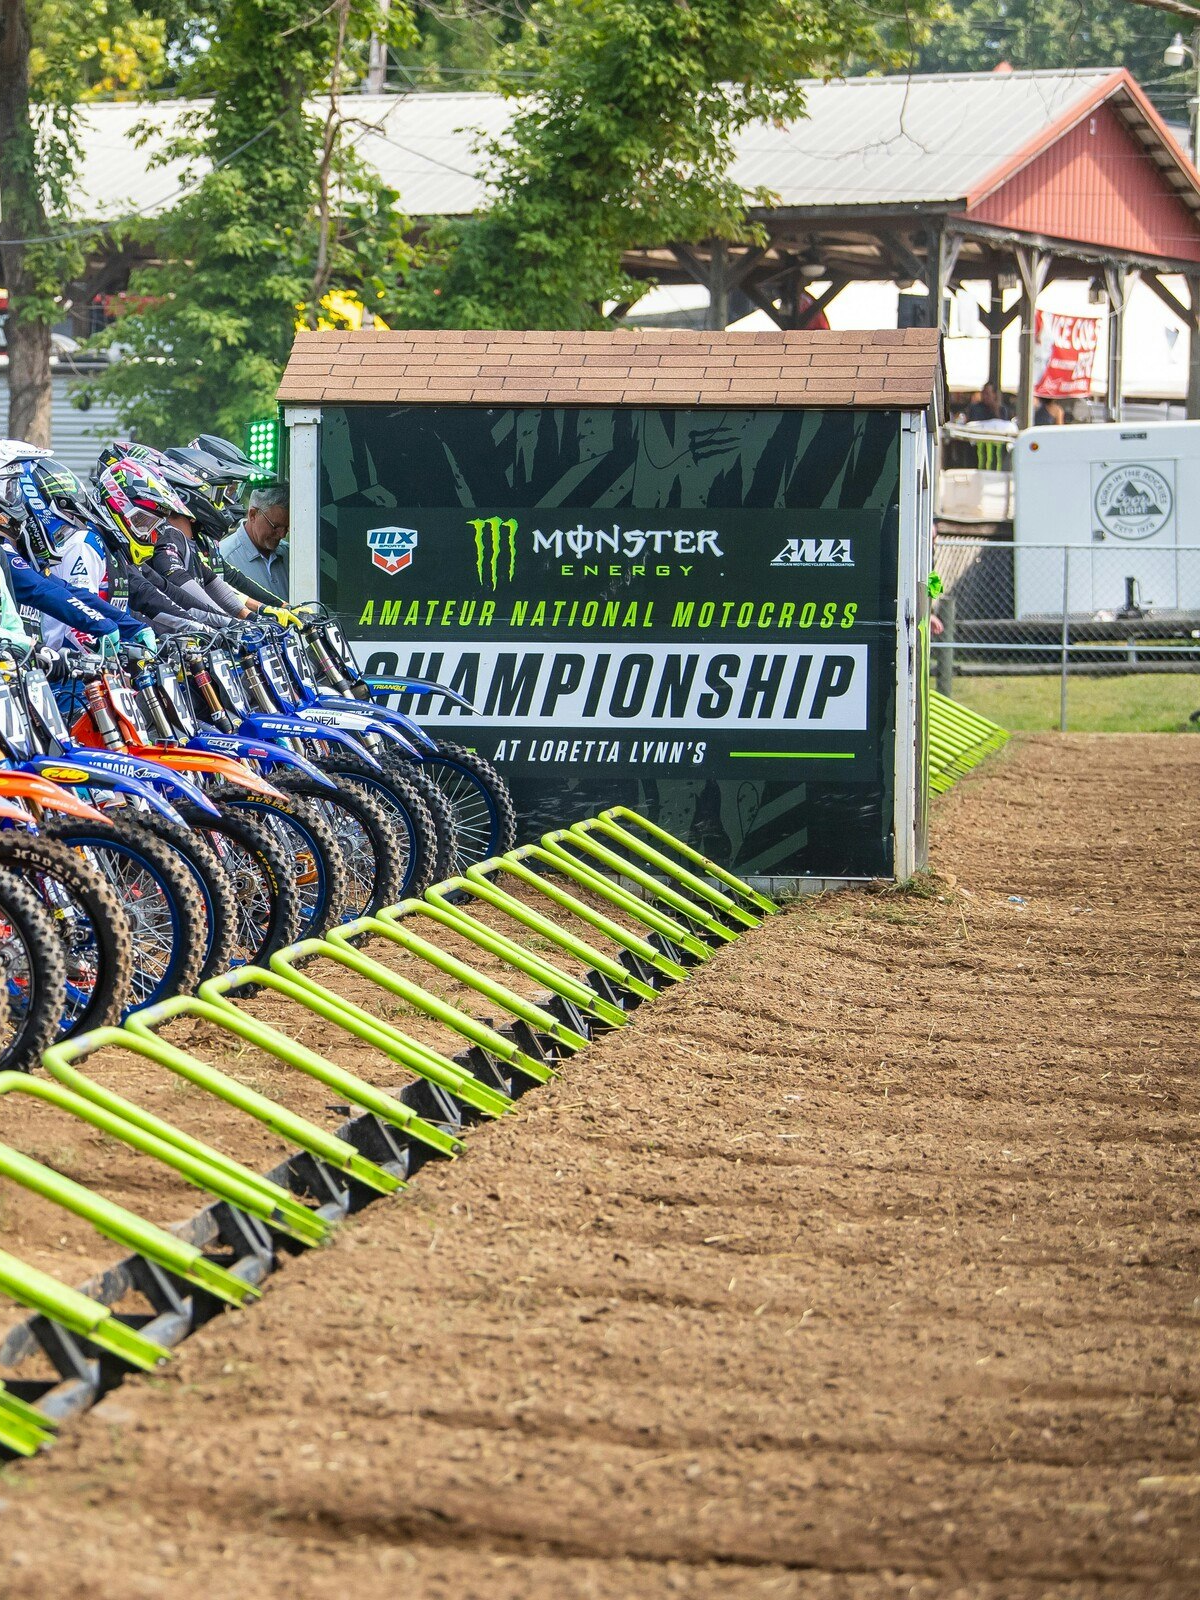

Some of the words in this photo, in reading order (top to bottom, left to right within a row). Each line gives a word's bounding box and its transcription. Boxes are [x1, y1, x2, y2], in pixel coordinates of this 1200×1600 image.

[369, 531, 417, 545] MX
[532, 524, 724, 559] MONSTER
[770, 538, 855, 563] AMA
[561, 565, 693, 577] ENERGY
[66, 596, 106, 622] THOR
[358, 600, 496, 626] AMATEUR
[509, 600, 654, 628] NATIONAL
[671, 602, 858, 629] MOTOCROSS
[261, 722, 319, 734] BILL'S
[91, 751, 135, 764] FOX
[493, 740, 521, 761] AT
[527, 741, 620, 763] LORETTA
[629, 742, 707, 764] LYNN'S
[88, 761, 135, 778] YAMAHA
[246, 794, 296, 815] DUNLOP
